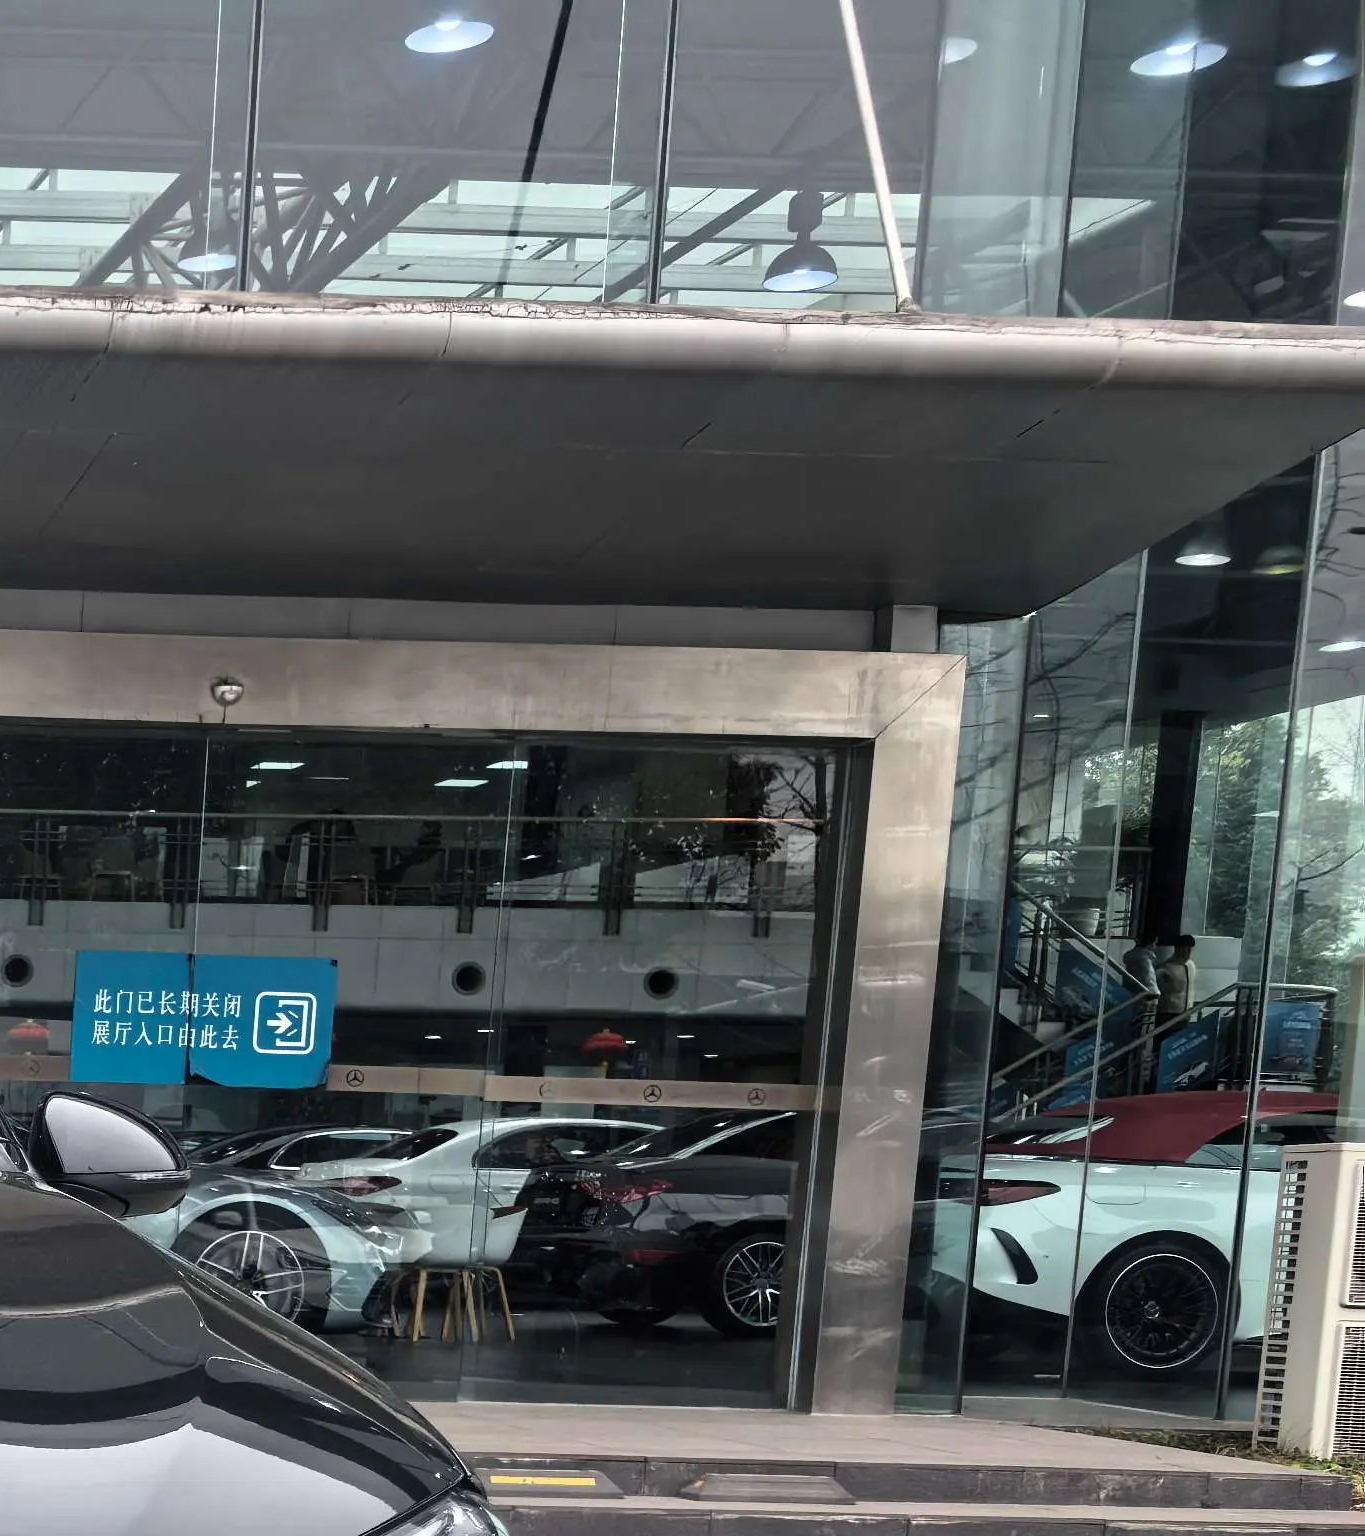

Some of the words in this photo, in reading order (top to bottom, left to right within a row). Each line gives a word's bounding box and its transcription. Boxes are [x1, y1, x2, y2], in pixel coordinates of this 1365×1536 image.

[93, 989, 242, 1019] 此门已长期关闭
[91, 1020, 240, 1051] 展厅入口由此去
